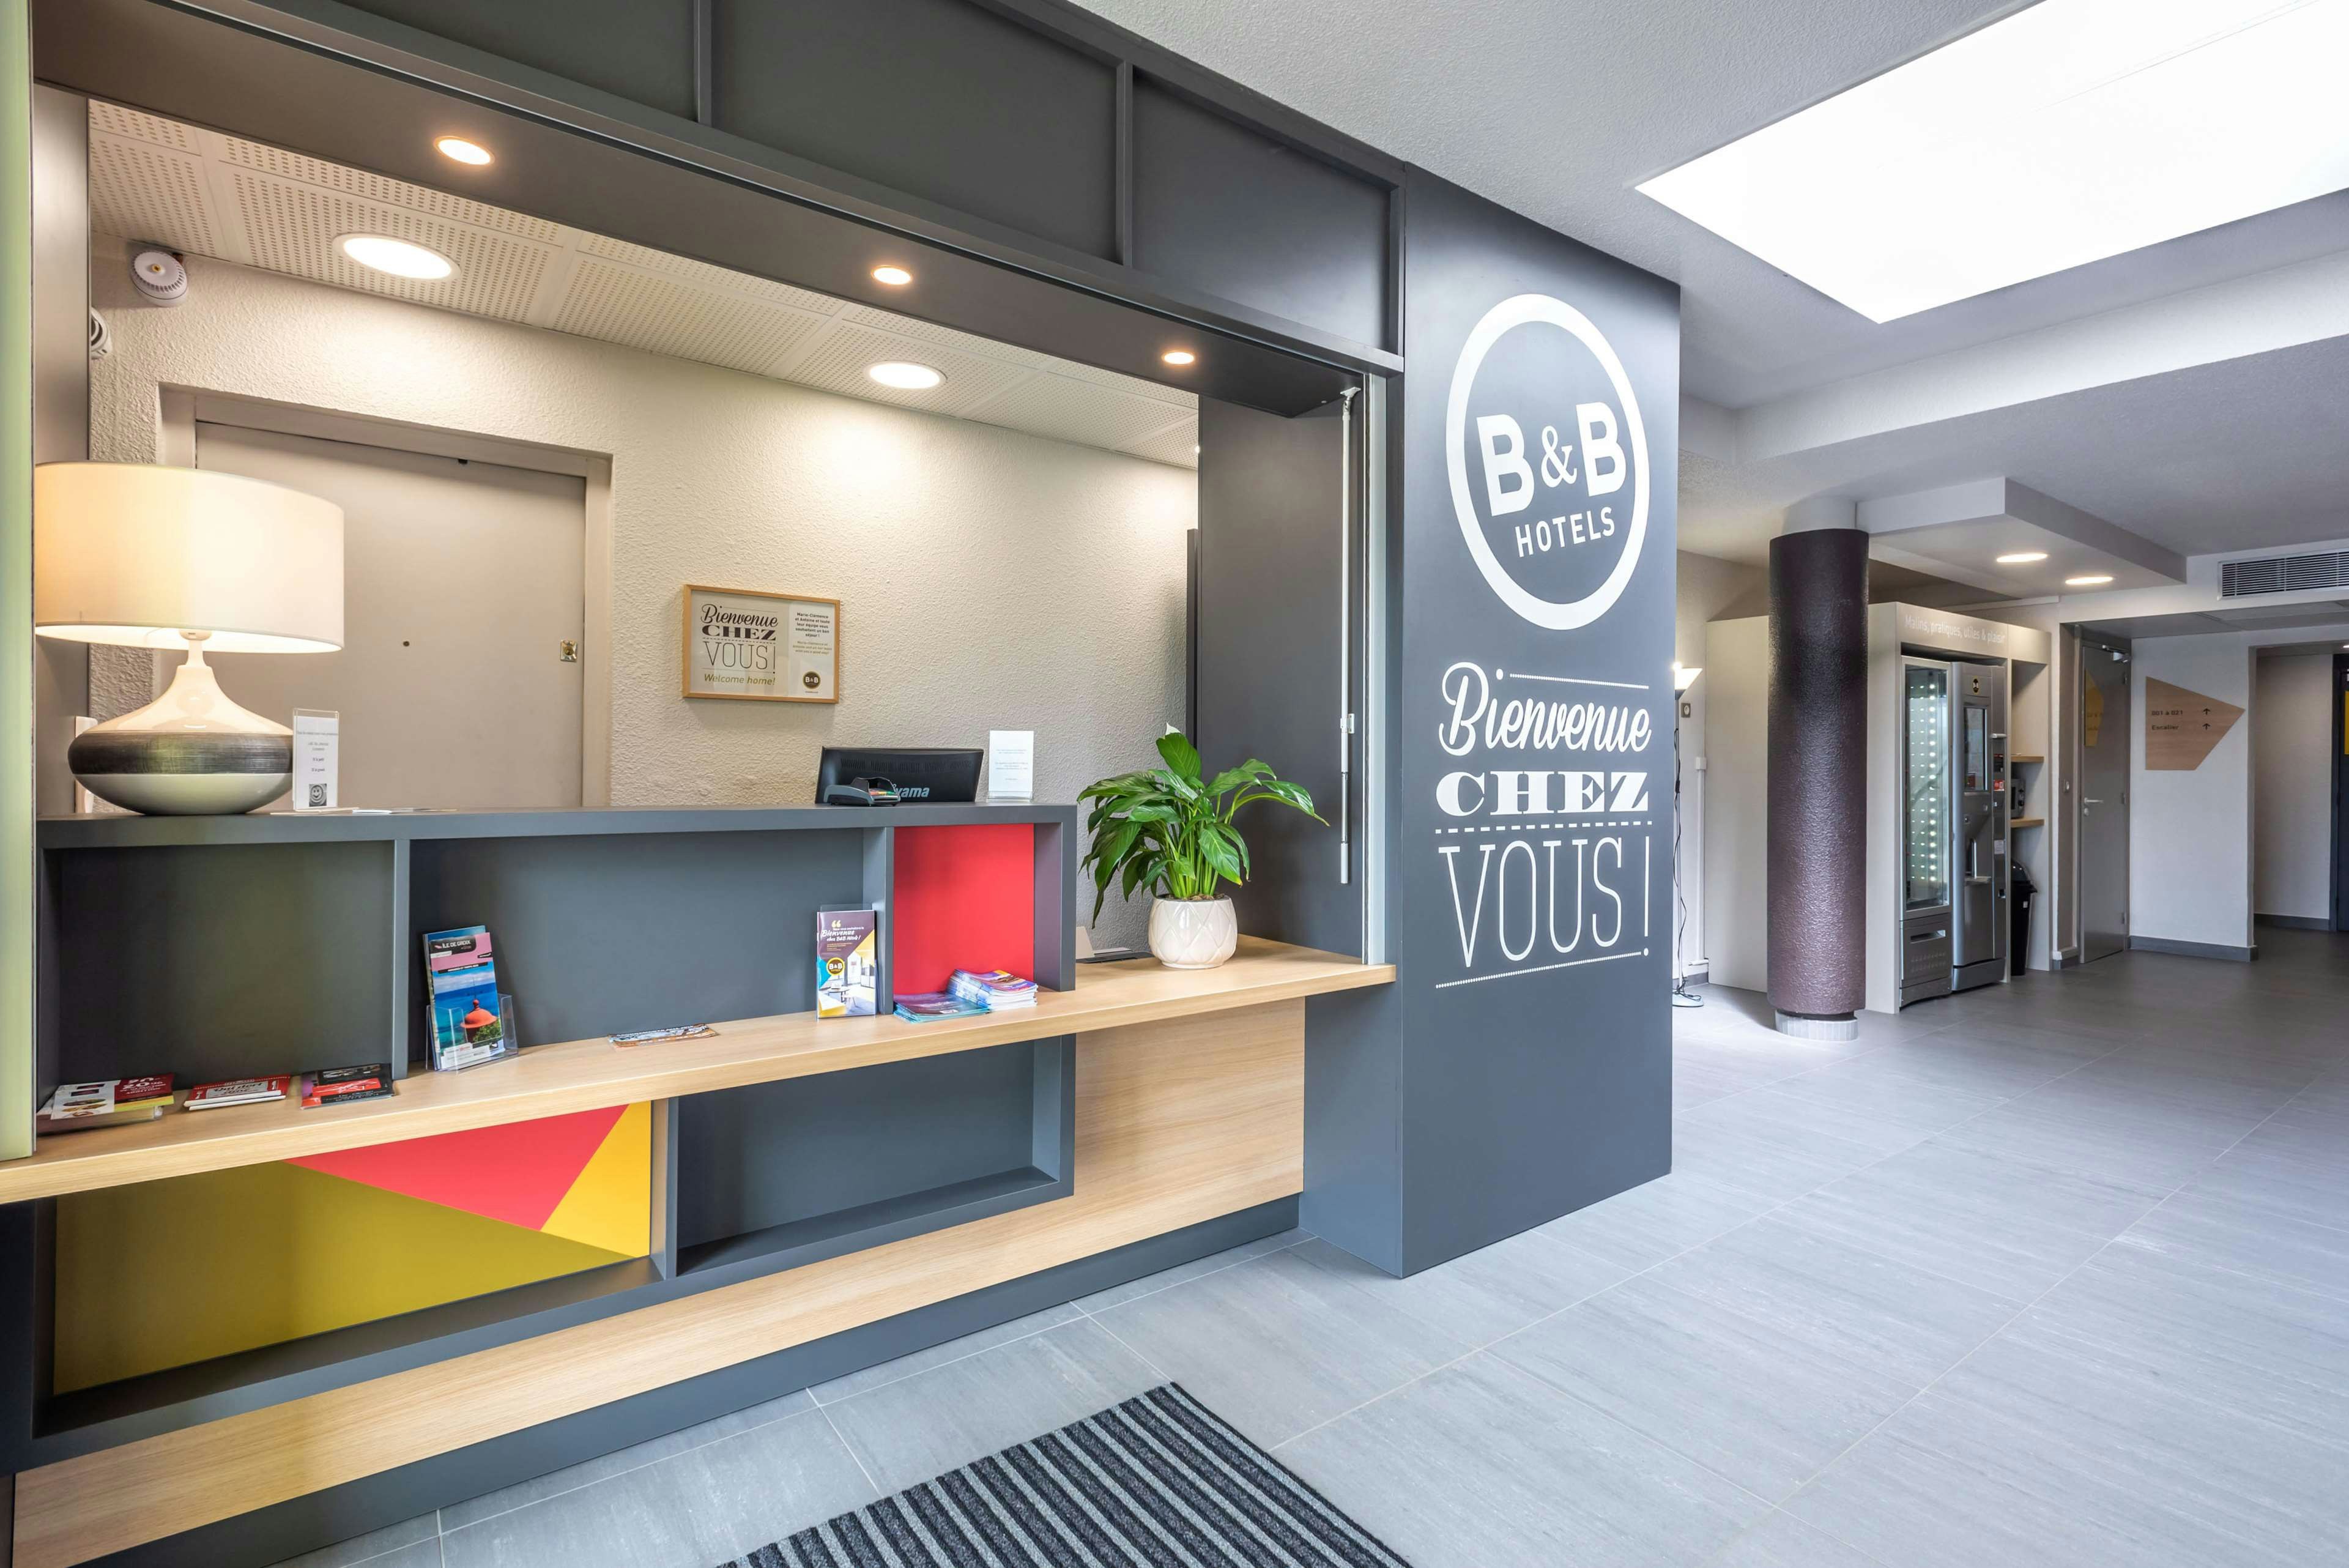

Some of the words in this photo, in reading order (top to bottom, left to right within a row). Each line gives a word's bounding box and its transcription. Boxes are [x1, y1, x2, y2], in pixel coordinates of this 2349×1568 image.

[1476, 401, 1627, 516] B&B
[1515, 506, 1615, 557] HOTELS
[700, 604, 778, 627] Bienvenue
[1931, 620, 1962, 638] pratiques,
[702, 625, 776, 641] CHEZ
[704, 674, 744, 683] Welcome
[747, 676, 776, 685] home!
[1438, 661, 1652, 756] Bienvenue
[1436, 771, 1649, 817] CHEZ
